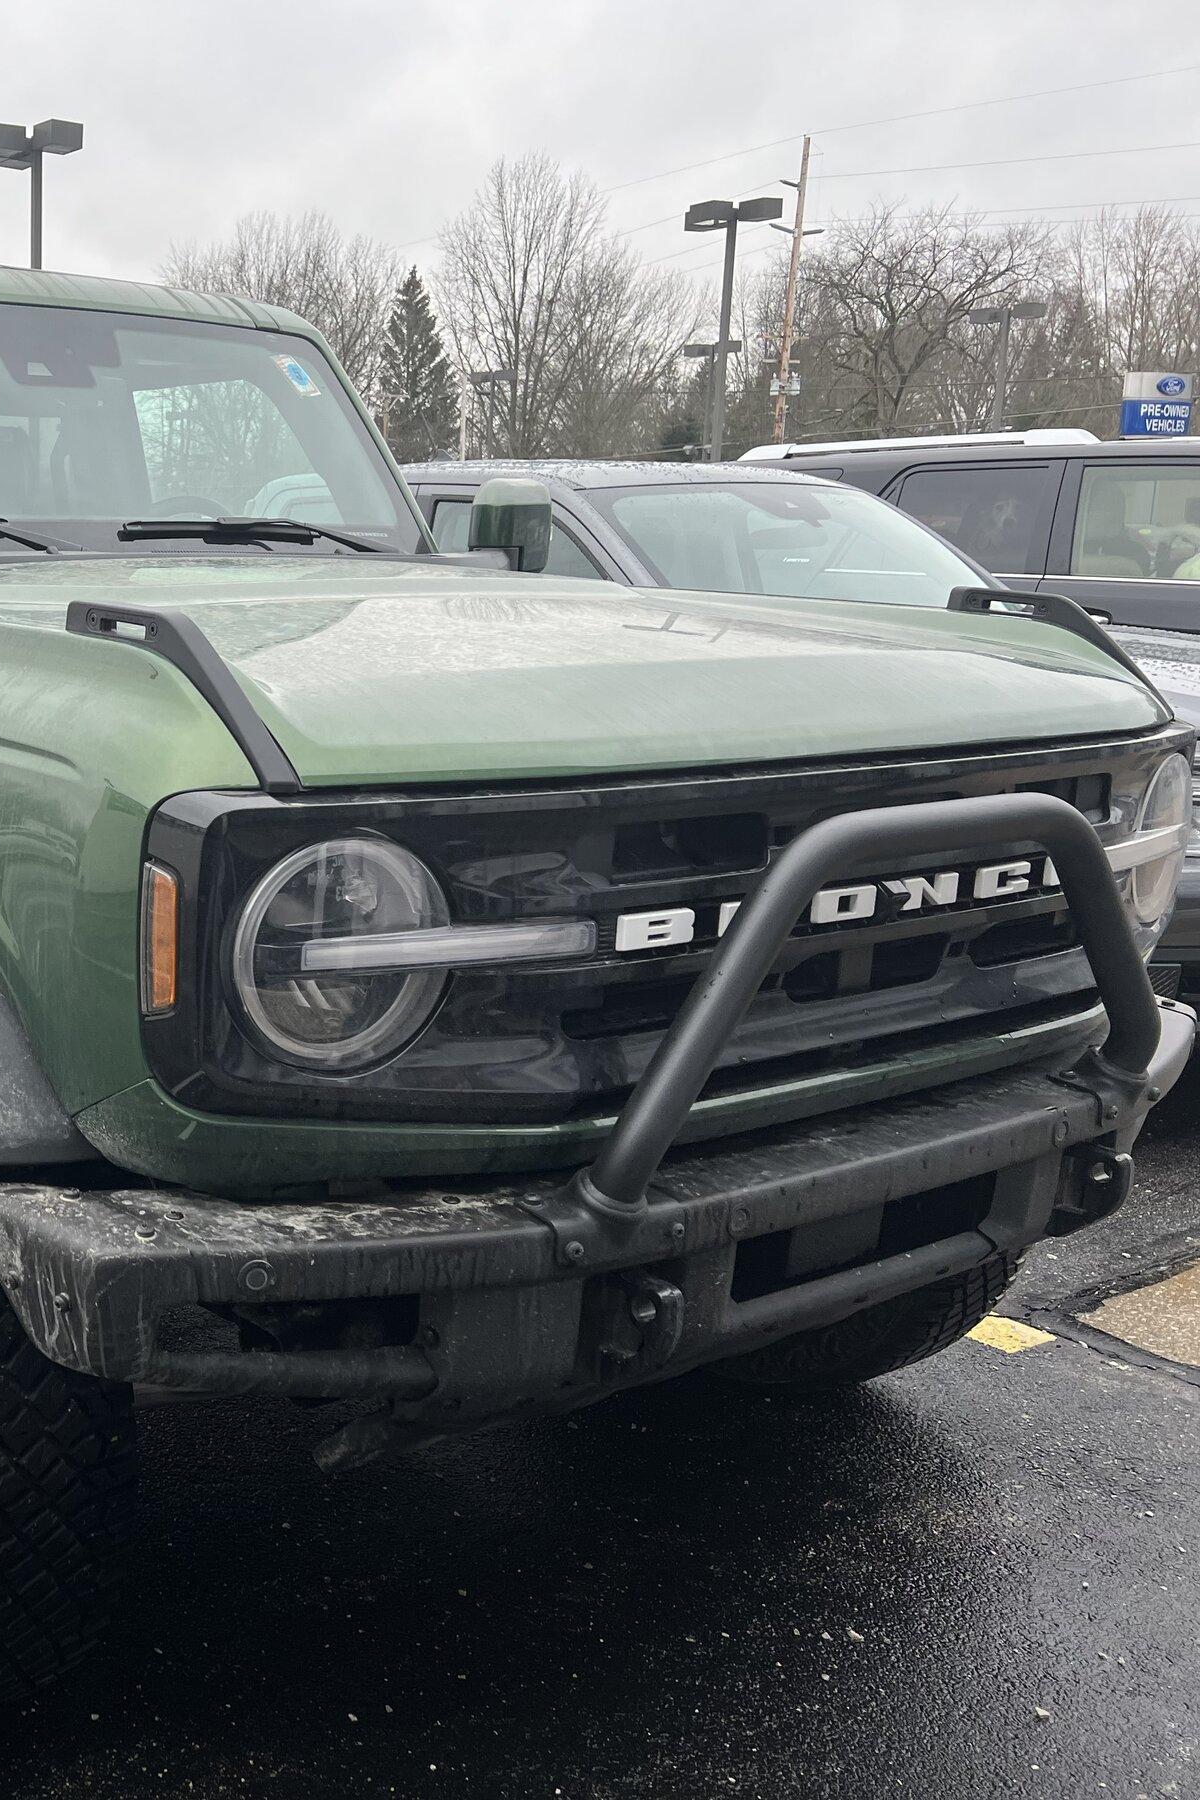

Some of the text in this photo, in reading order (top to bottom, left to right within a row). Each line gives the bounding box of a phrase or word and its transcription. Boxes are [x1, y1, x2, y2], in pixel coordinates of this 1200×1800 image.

[1140, 404, 1190, 418] PRE-OWNED
[1145, 418, 1186, 433] VEHICLES
[615, 856, 1061, 952] BONC
